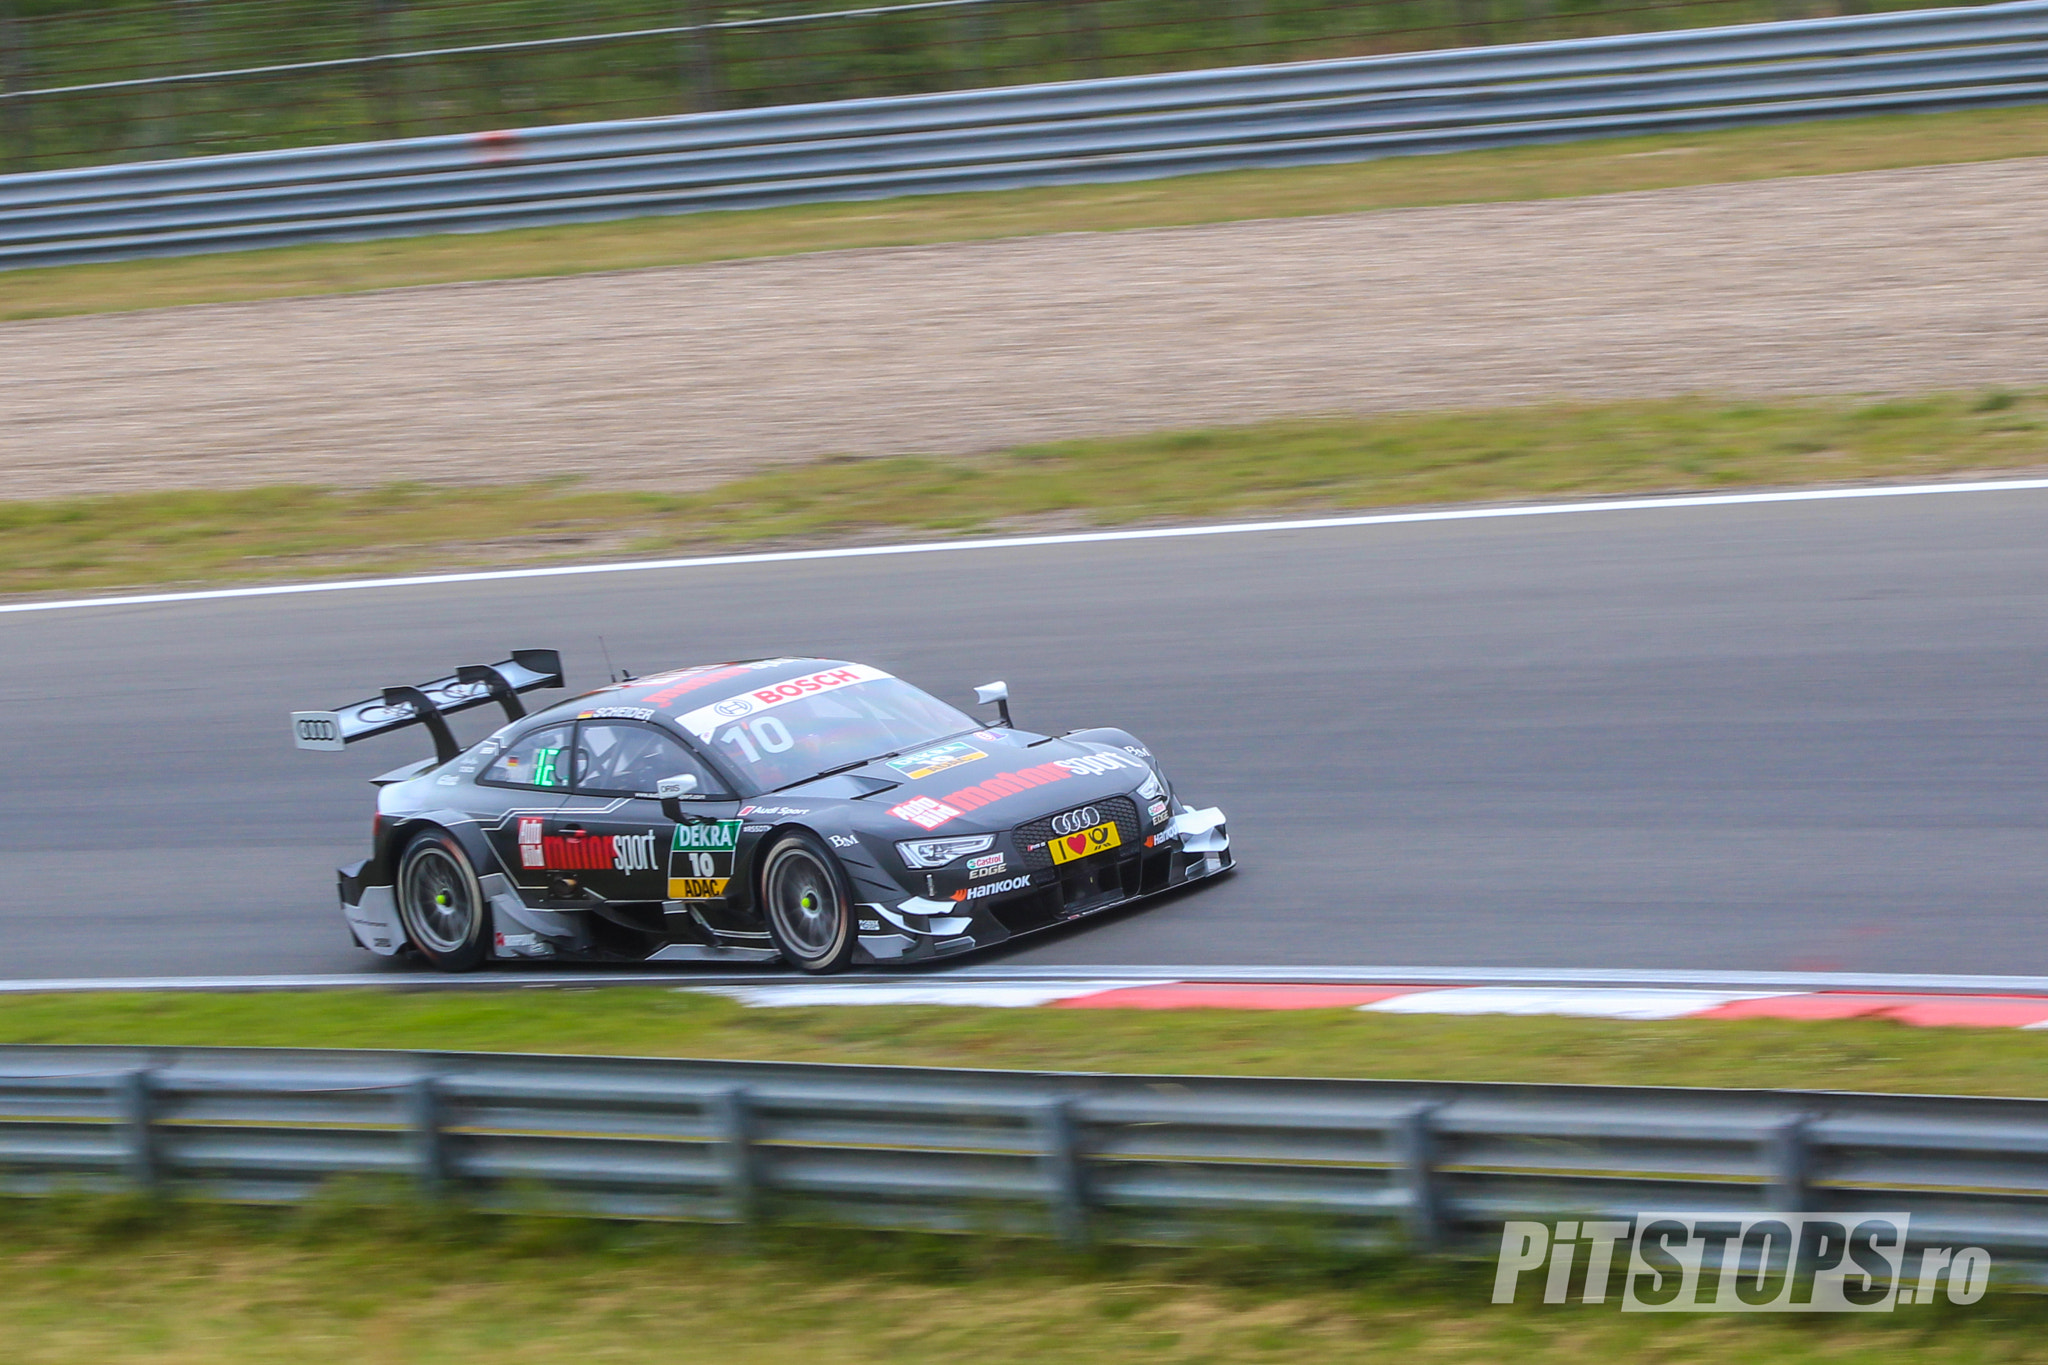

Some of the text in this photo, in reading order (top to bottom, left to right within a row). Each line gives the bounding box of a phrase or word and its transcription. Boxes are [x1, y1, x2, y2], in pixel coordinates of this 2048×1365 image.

[752, 669, 861, 704] BOSCH
[593, 706, 655, 721] SCHEIDER
[720, 716, 795, 763] 10
[895, 743, 963, 765] DEKRA
[753, 806, 811, 816] Audi Sport
[680, 825, 733, 847] DEKRA
[688, 852, 716, 877] 10
[976, 854, 1003, 867] Castrol
[969, 863, 1008, 880] EDGE
[684, 880, 720, 897] ADAC
